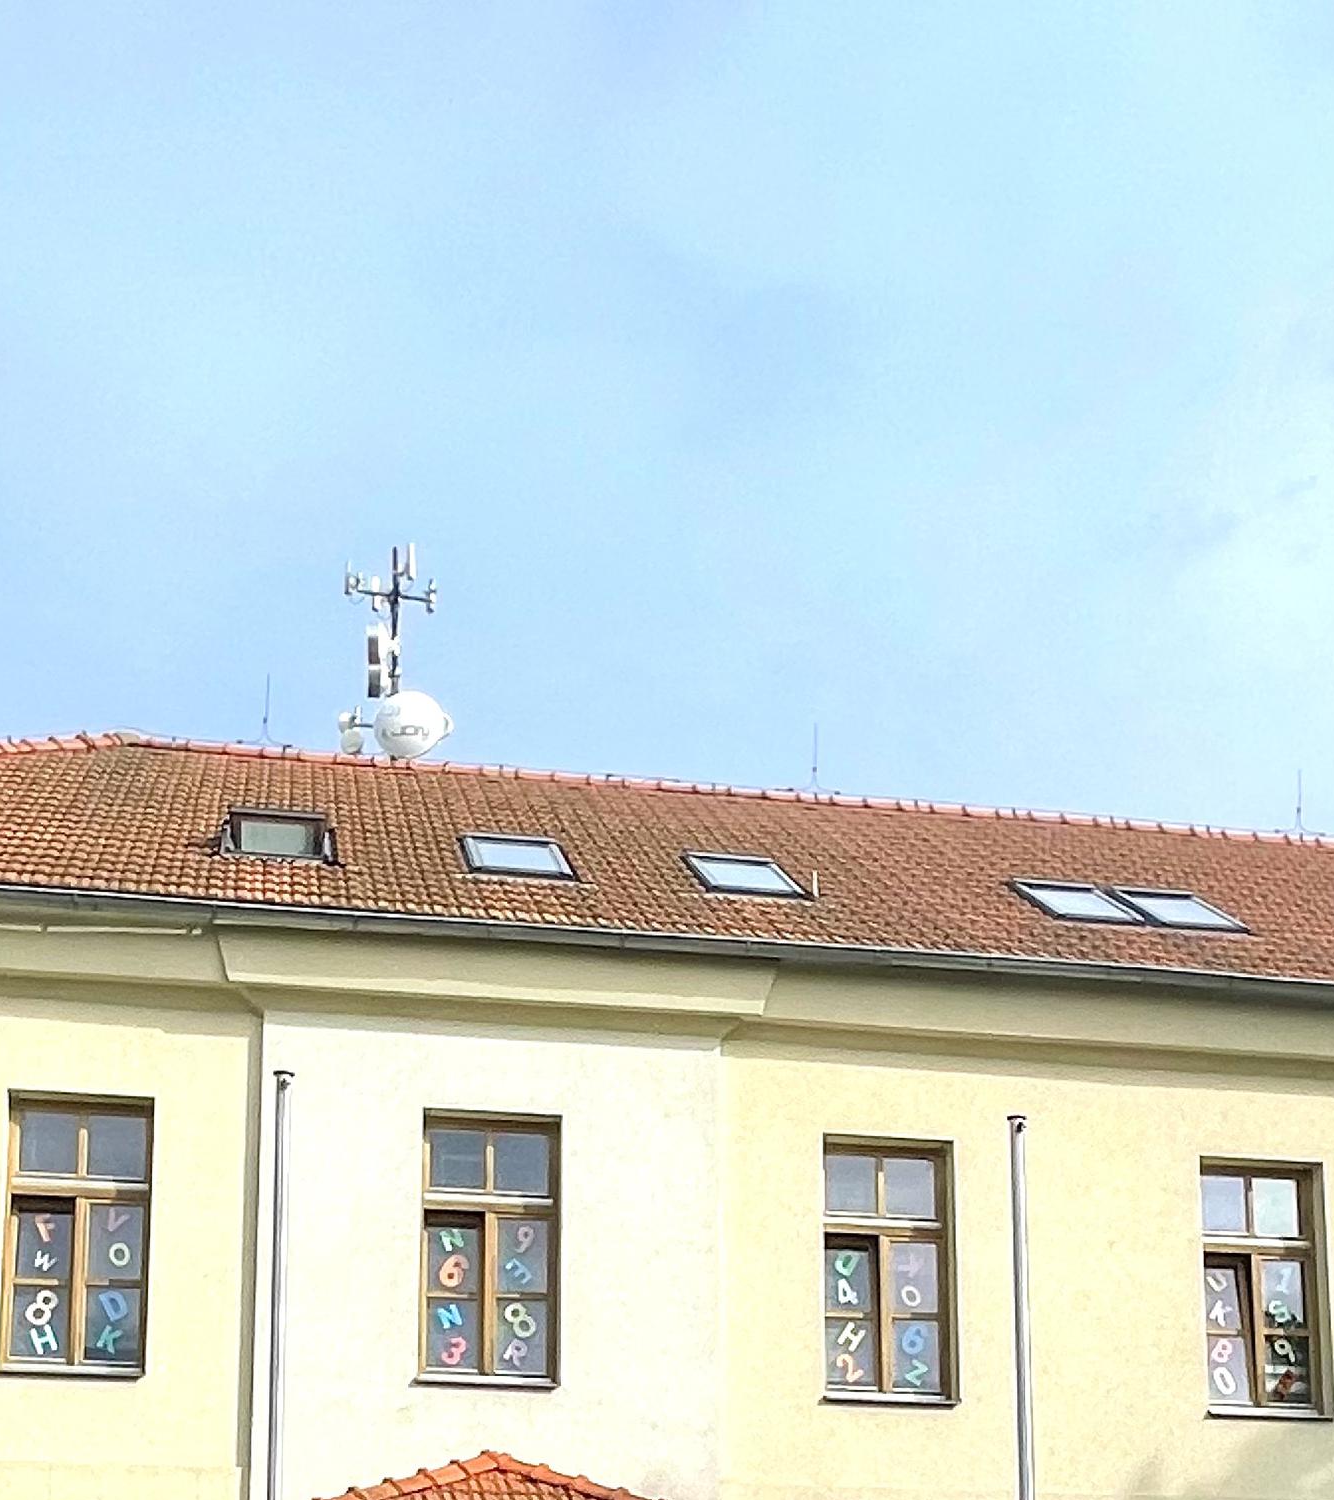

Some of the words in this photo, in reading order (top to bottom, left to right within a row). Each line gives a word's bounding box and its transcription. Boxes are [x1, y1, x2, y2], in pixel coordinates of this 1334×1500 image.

[439, 1254, 469, 1287] 6
[25, 1290, 58, 1325] 8
[99, 1290, 128, 1322] D
[437, 1304, 463, 1329] N
[504, 1303, 536, 1338] 8
[30, 1324, 58, 1355] H
[96, 1325, 123, 1354] K
[837, 1321, 866, 1352] H
[902, 1324, 928, 1355] 6
[503, 1338, 528, 1368] R
[836, 1353, 864, 1382] 2
